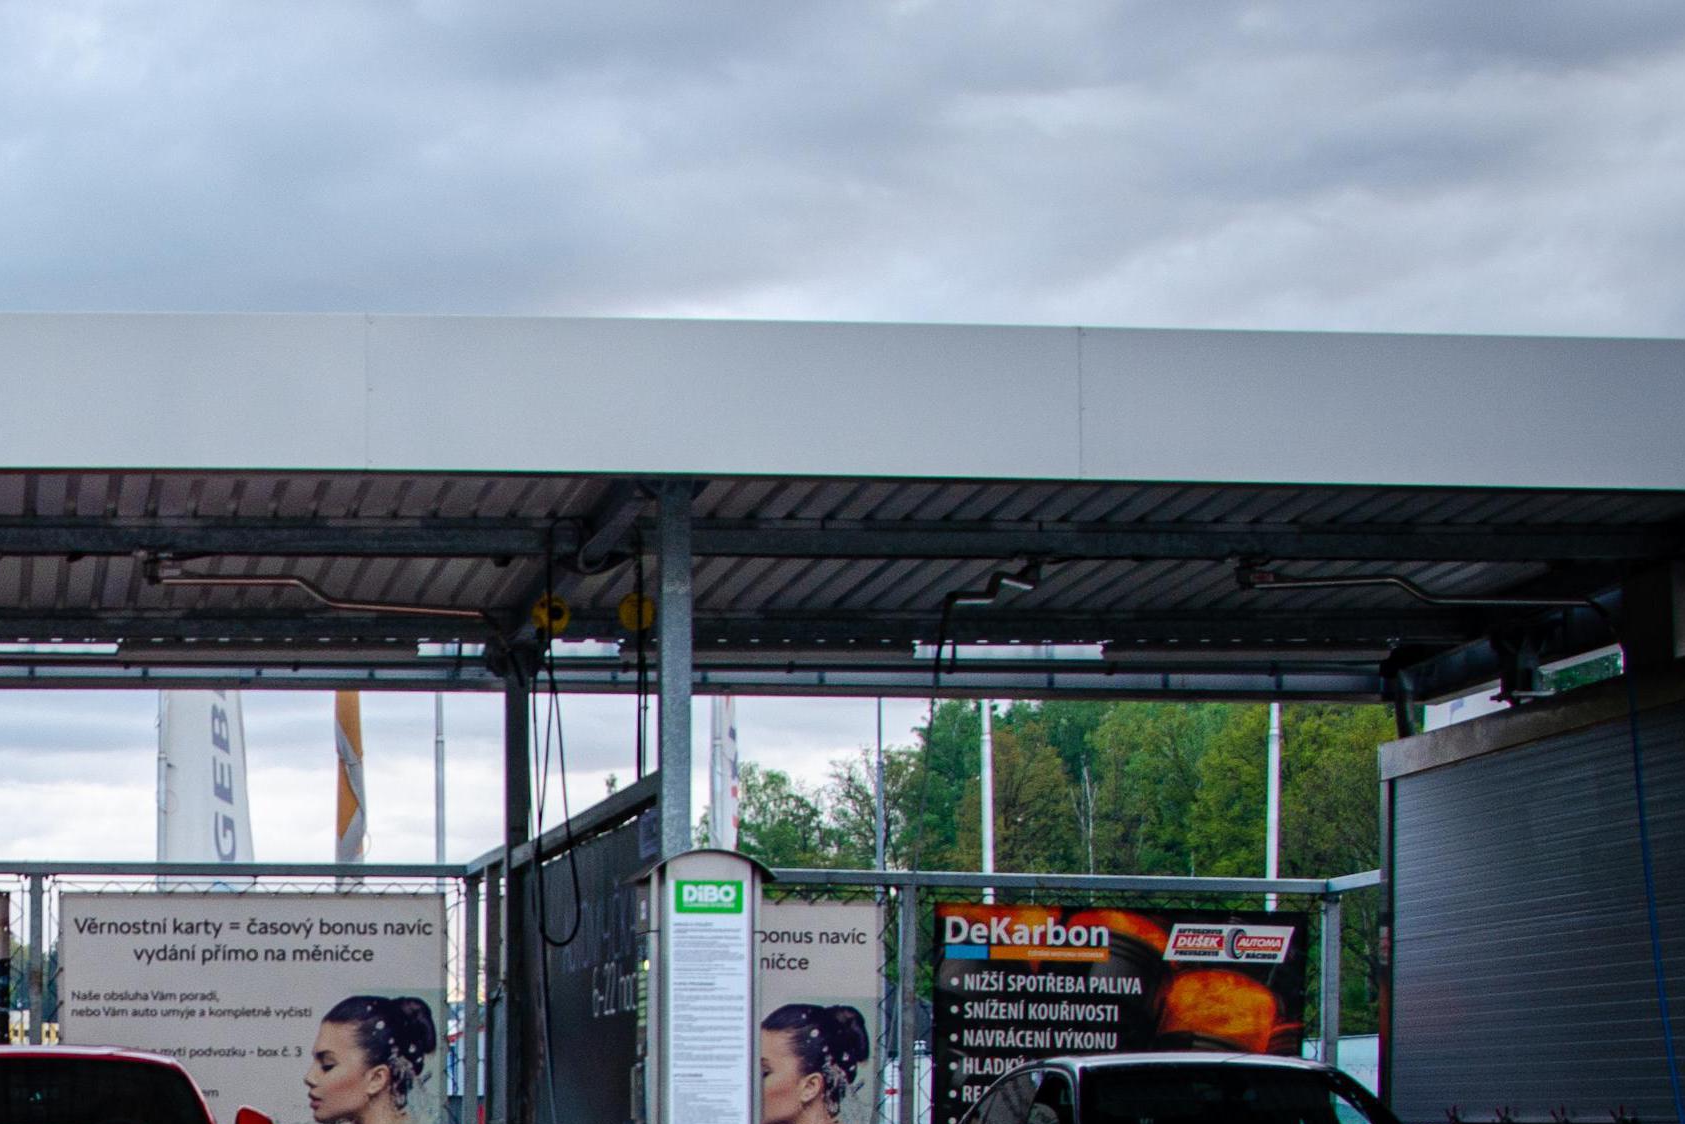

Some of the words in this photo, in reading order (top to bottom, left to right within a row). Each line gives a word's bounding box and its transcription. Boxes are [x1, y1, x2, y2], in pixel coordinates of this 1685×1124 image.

[74, 917, 167, 935] Věrnostní
[173, 918, 222, 938] karty
[247, 917, 314, 938] časový
[319, 918, 378, 935] bonus
[384, 918, 433, 936] navíc
[819, 928, 867, 944] navíc
[944, 916, 1110, 947] DeKarbon
[1177, 934, 1221, 947] DUŠEK
[1237, 938, 1282, 948] AUTOMA
[133, 944, 195, 965] vydání
[202, 944, 259, 965] přímo
[264, 949, 286, 961] na
[292, 944, 374, 962] měničce
[760, 953, 810, 970] ničce
[964, 971, 1004, 991] NIŽŠÍ
[1007, 972, 1086, 993] SPOTŘEBA
[1089, 975, 1142, 994] PALIVA
[71, 991, 100, 1000] Naše
[103, 990, 149, 1001] obsluha
[150, 990, 177, 1000] Vám
[71, 1006, 101, 1017] nebo
[102, 1006, 128, 1017] Vám
[131, 1007, 158, 1017] auto
[160, 1007, 196, 1019] umyje
[199, 1008, 206, 1017] a
[208, 1006, 272, 1019] kompletně
[964, 999, 1025, 1020] SNÍŽENÍ
[1028, 1001, 1119, 1022] KOUŘIVOSTI
[963, 1027, 1051, 1048] NAVRÁCENÍ
[1054, 1029, 1118, 1049] VÝKONU
[189, 1046, 246, 1059] podvozku
[257, 1046, 278, 1057] box
[294, 1046, 302, 1057] 3
